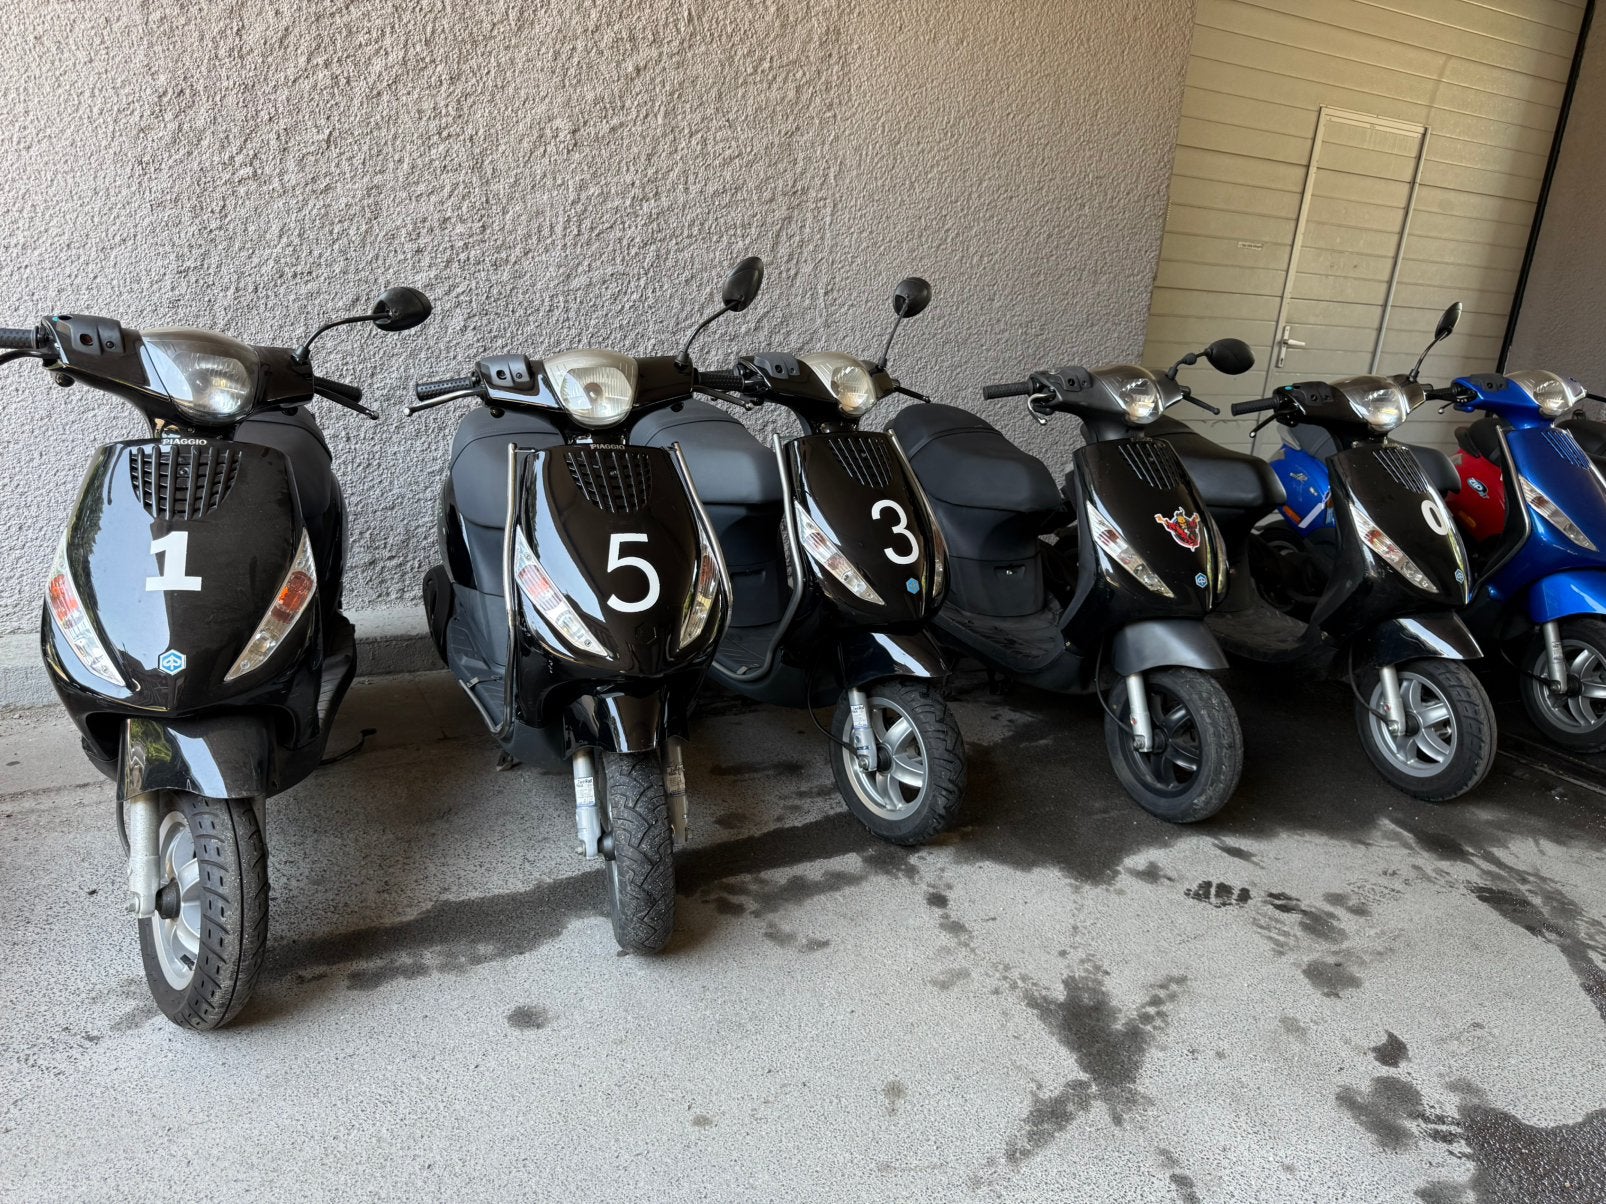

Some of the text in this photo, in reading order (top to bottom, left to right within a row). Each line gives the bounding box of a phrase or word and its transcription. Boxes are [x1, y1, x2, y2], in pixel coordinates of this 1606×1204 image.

[162, 438, 207, 446] PIAGGIO
[871, 499, 920, 565] 3
[1421, 499, 1449, 536] 0
[145, 531, 202, 592] 1
[606, 532, 661, 613] 5
